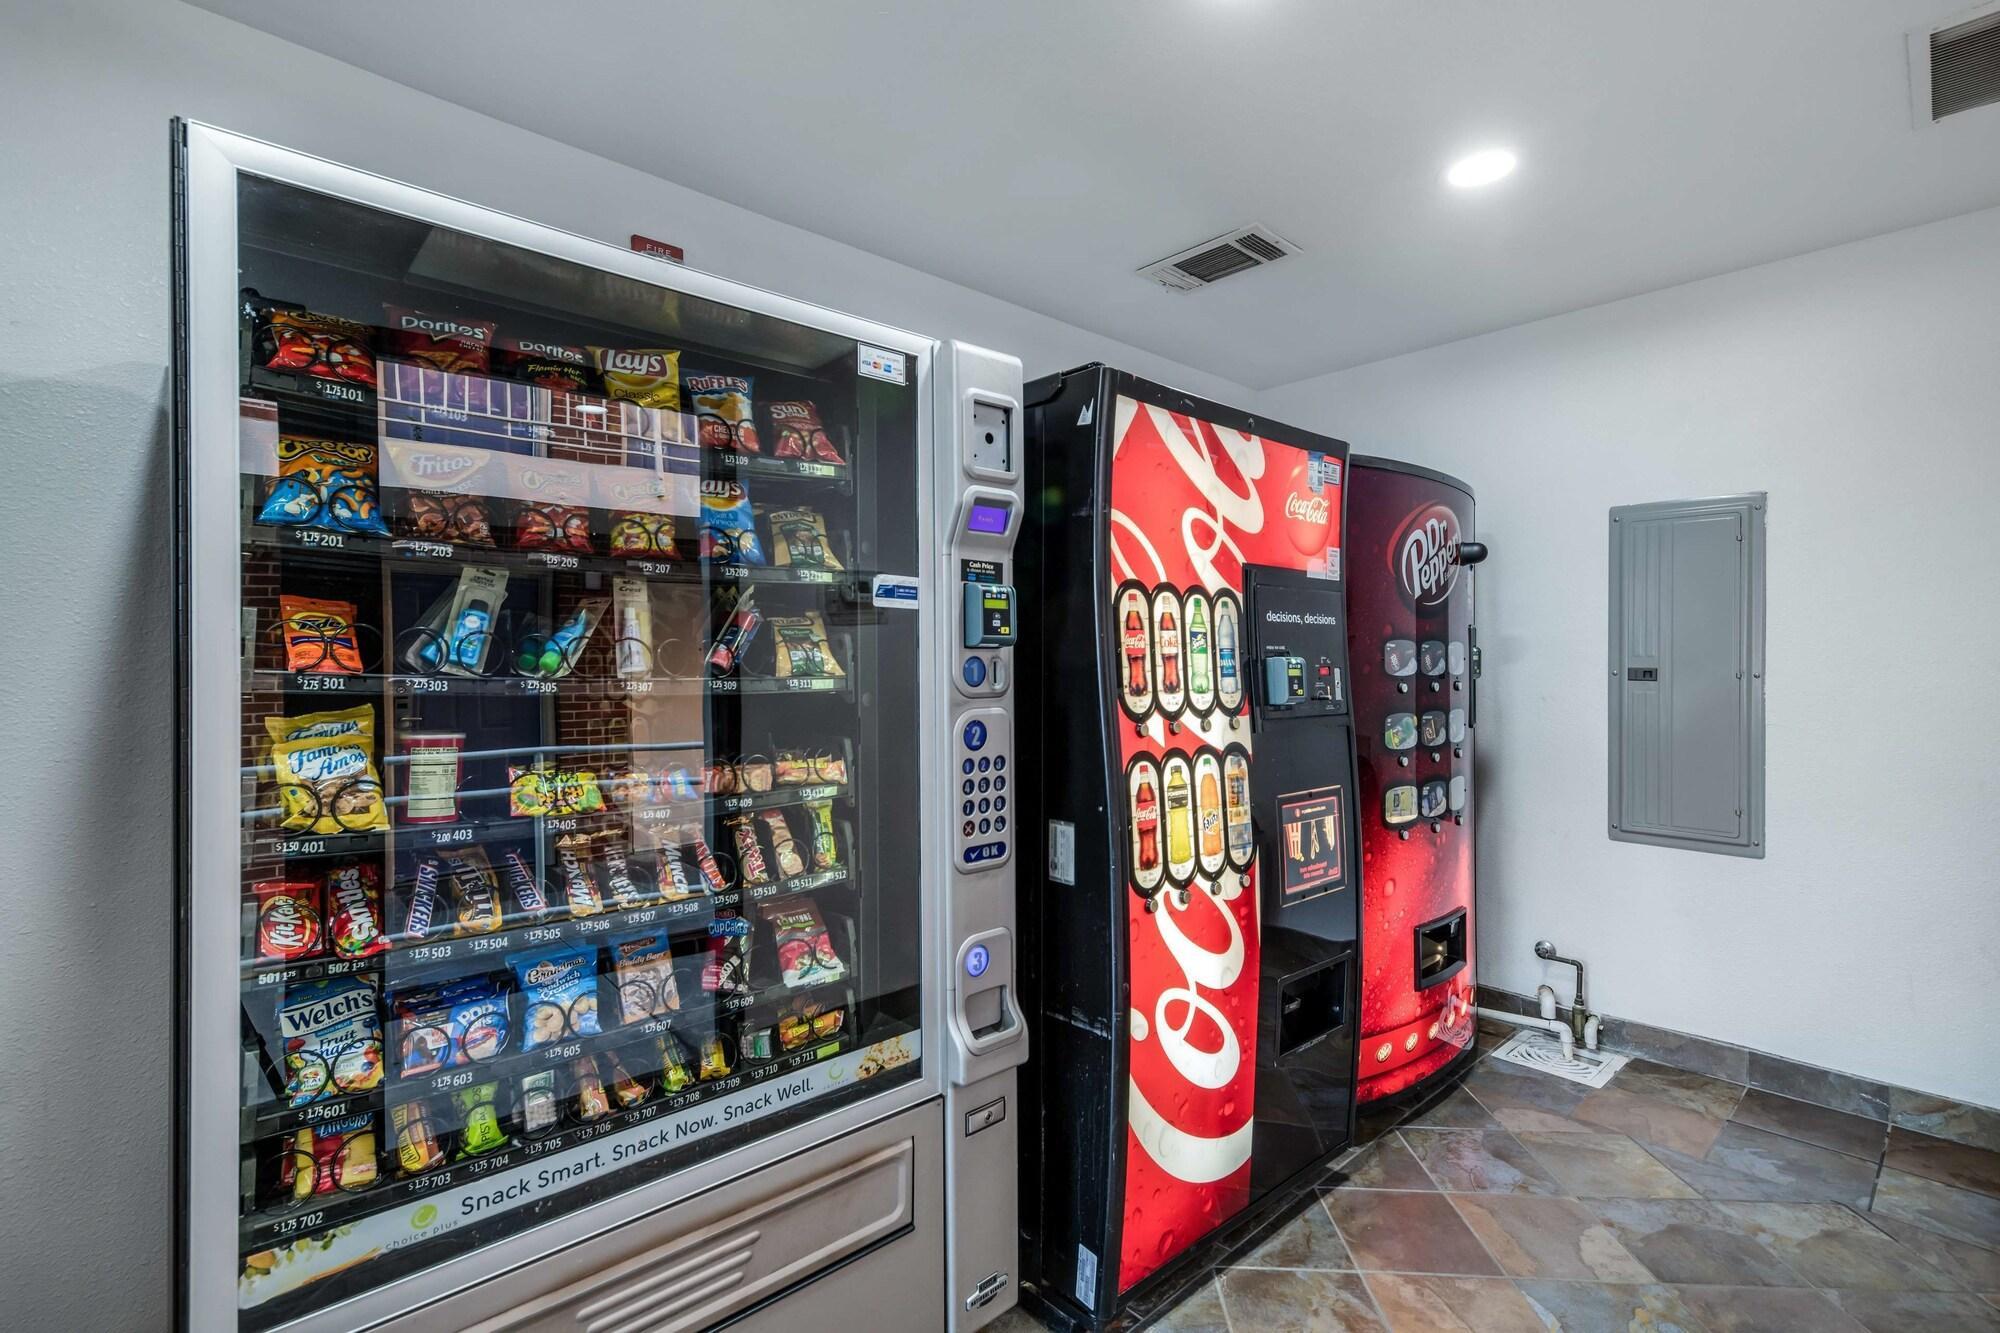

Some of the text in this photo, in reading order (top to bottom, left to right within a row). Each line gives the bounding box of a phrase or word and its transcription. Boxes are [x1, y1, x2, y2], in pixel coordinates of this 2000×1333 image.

[646, 244, 672, 256] FIRE
[401, 315, 484, 340] Doritos
[519, 341, 584, 364] Doritos
[687, 375, 748, 394] RUFFLES
[341, 386, 363, 402] 101
[614, 388, 660, 403] Classic
[277, 440, 371, 462] Cheetos
[410, 454, 472, 475] Fritos
[735, 456, 749, 466] 109
[1285, 491, 1330, 525] Coca-Cola
[321, 535, 344, 549] 201
[1425, 518, 1449, 558] Dr
[432, 549, 454, 562] 203
[561, 557, 578, 569] 205
[655, 563, 671, 577] 207
[981, 561, 995, 570] Price
[1401, 528, 1461, 601] Pepper
[735, 568, 749, 577] 209
[1266, 611, 1336, 625] decisions, decisions
[970, 662, 979, 682] 1
[322, 678, 345, 691] 301
[427, 680, 449, 692] 303
[539, 682, 557, 693] 305
[637, 682, 653, 692] 307
[723, 682, 736, 690] 309
[970, 725, 982, 747] 2
[312, 751, 366, 780] Amos
[965, 758, 1002, 772] 1 2 3
[964, 778, 1003, 793] 4 5 6
[738, 798, 752, 808] 409
[965, 798, 1002, 814] 7 8 9
[655, 809, 671, 820] 407
[559, 819, 576, 831] 405
[452, 829, 473, 841] 403
[301, 841, 326, 854] 401
[982, 846, 999, 858] OK
[834, 870, 847, 880] 512
[763, 885, 777, 895] 510
[800, 878, 813, 888] 511
[335, 864, 376, 941] Skittles
[406, 863, 439, 940] SNICKERS
[725, 894, 739, 905] 509
[683, 902, 699, 914] 508
[640, 911, 656, 923] 507
[593, 919, 610, 931] 506
[543, 930, 561, 941] 505
[489, 936, 509, 950] 504
[431, 946, 452, 959] 503
[972, 948, 983, 968] 3
[328, 962, 350, 977] 502
[258, 971, 282, 984] 501
[537, 970, 581, 994] Sandwich
[540, 978, 580, 1001] Cremes
[740, 995, 754, 1008] 609
[284, 991, 374, 1032] Welch's
[656, 1019, 672, 1032] 607
[319, 1029, 358, 1050] Fruit
[563, 1044, 581, 1058] 605
[801, 1051, 815, 1063] 711
[764, 1063, 778, 1076] 710
[452, 1071, 473, 1087] 603
[726, 1076, 741, 1089] 709
[684, 1091, 700, 1103] 708
[323, 1103, 347, 1120] 601
[641, 1105, 657, 1119] 707
[594, 1121, 611, 1136] 706
[461, 1175, 532, 1216] Snack
[537, 1153, 607, 1190] Smart.
[613, 1125, 670, 1162] Snack
[675, 1114, 720, 1140] Now.
[723, 1090, 773, 1123] Snack
[776, 1077, 815, 1104] Well.
[544, 1138, 563, 1152] 705
[489, 1154, 510, 1169] 704
[430, 1172, 452, 1188] 703
[299, 1211, 324, 1228] 702
[385, 1217, 460, 1248] choice plus
